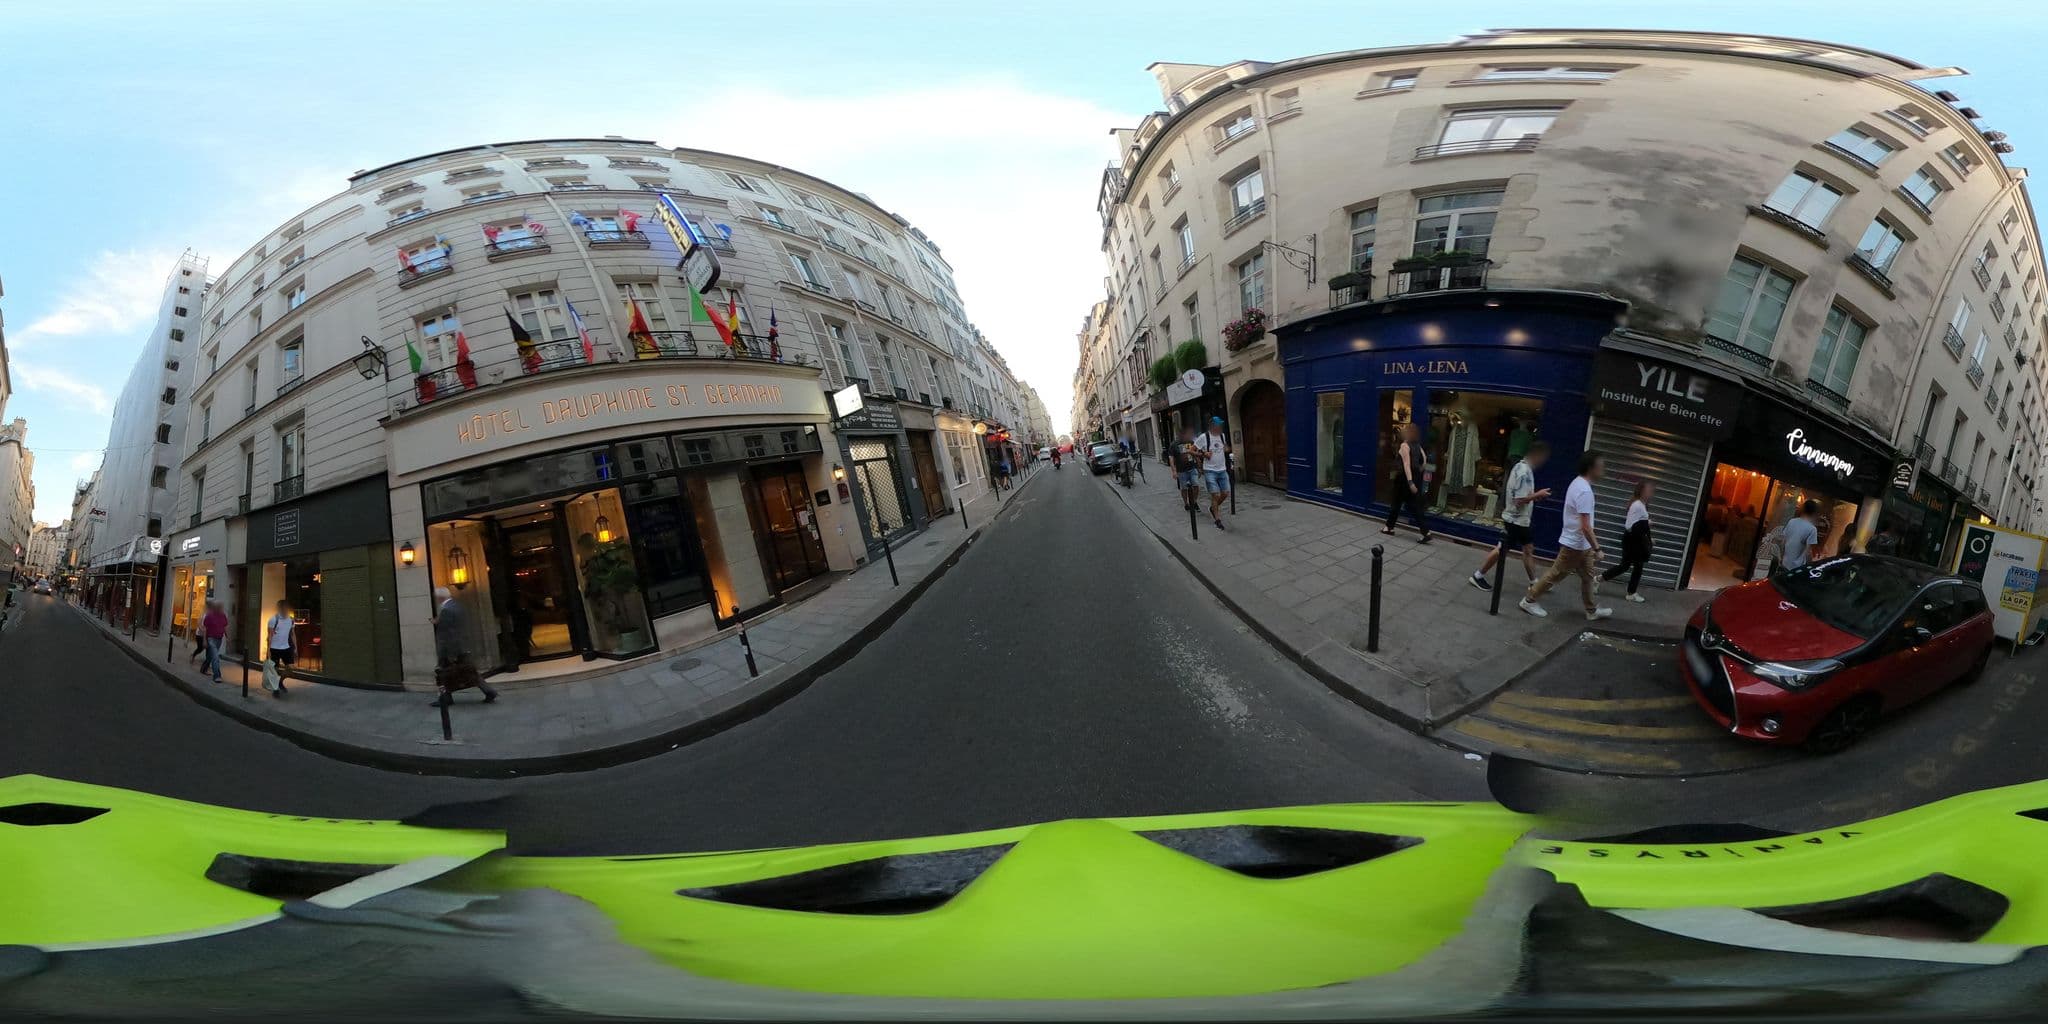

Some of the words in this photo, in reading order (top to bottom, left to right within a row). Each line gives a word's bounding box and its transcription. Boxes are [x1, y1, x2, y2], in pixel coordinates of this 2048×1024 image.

[1383, 362, 1415, 374] LINA
[1428, 361, 1469, 374] LENA
[1637, 361, 1706, 402] YILE
[457, 408, 530, 444] HÔTEL
[542, 387, 656, 425] DAUPHINE
[704, 384, 784, 405] GERMAIN
[1601, 388, 1648, 407] Institut
[1650, 400, 1666, 411] de
[1669, 403, 1698, 419] Bien
[1700, 413, 1722, 427] etre
[1786, 428, 1854, 476] Cinnamon
